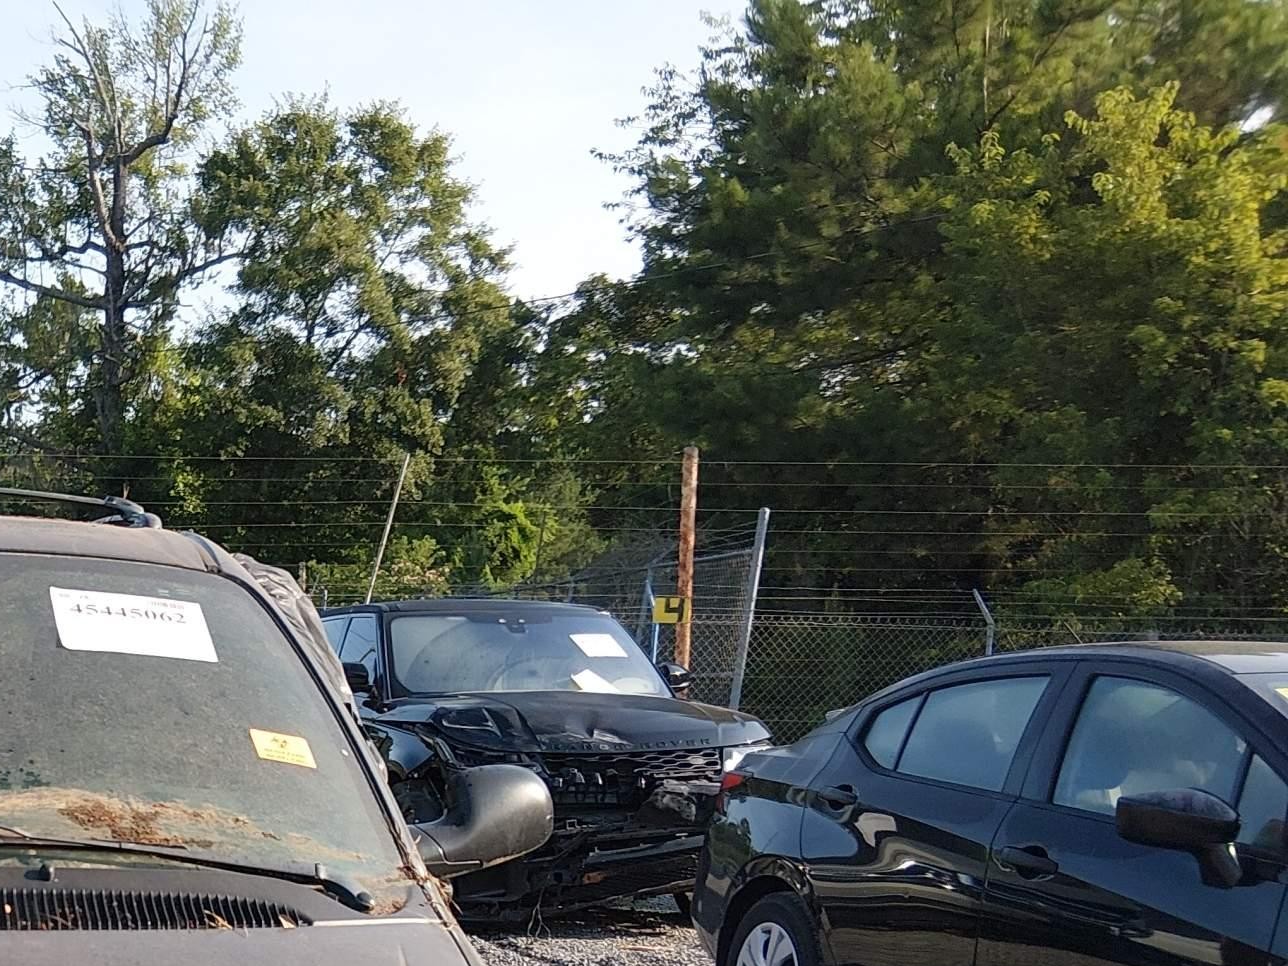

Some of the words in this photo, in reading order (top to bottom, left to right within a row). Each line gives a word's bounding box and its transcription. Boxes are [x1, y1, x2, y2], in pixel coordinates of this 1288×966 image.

[69, 603, 187, 624] 45445062
[664, 597, 686, 622] 4
[639, 738, 711, 750] ROVER
